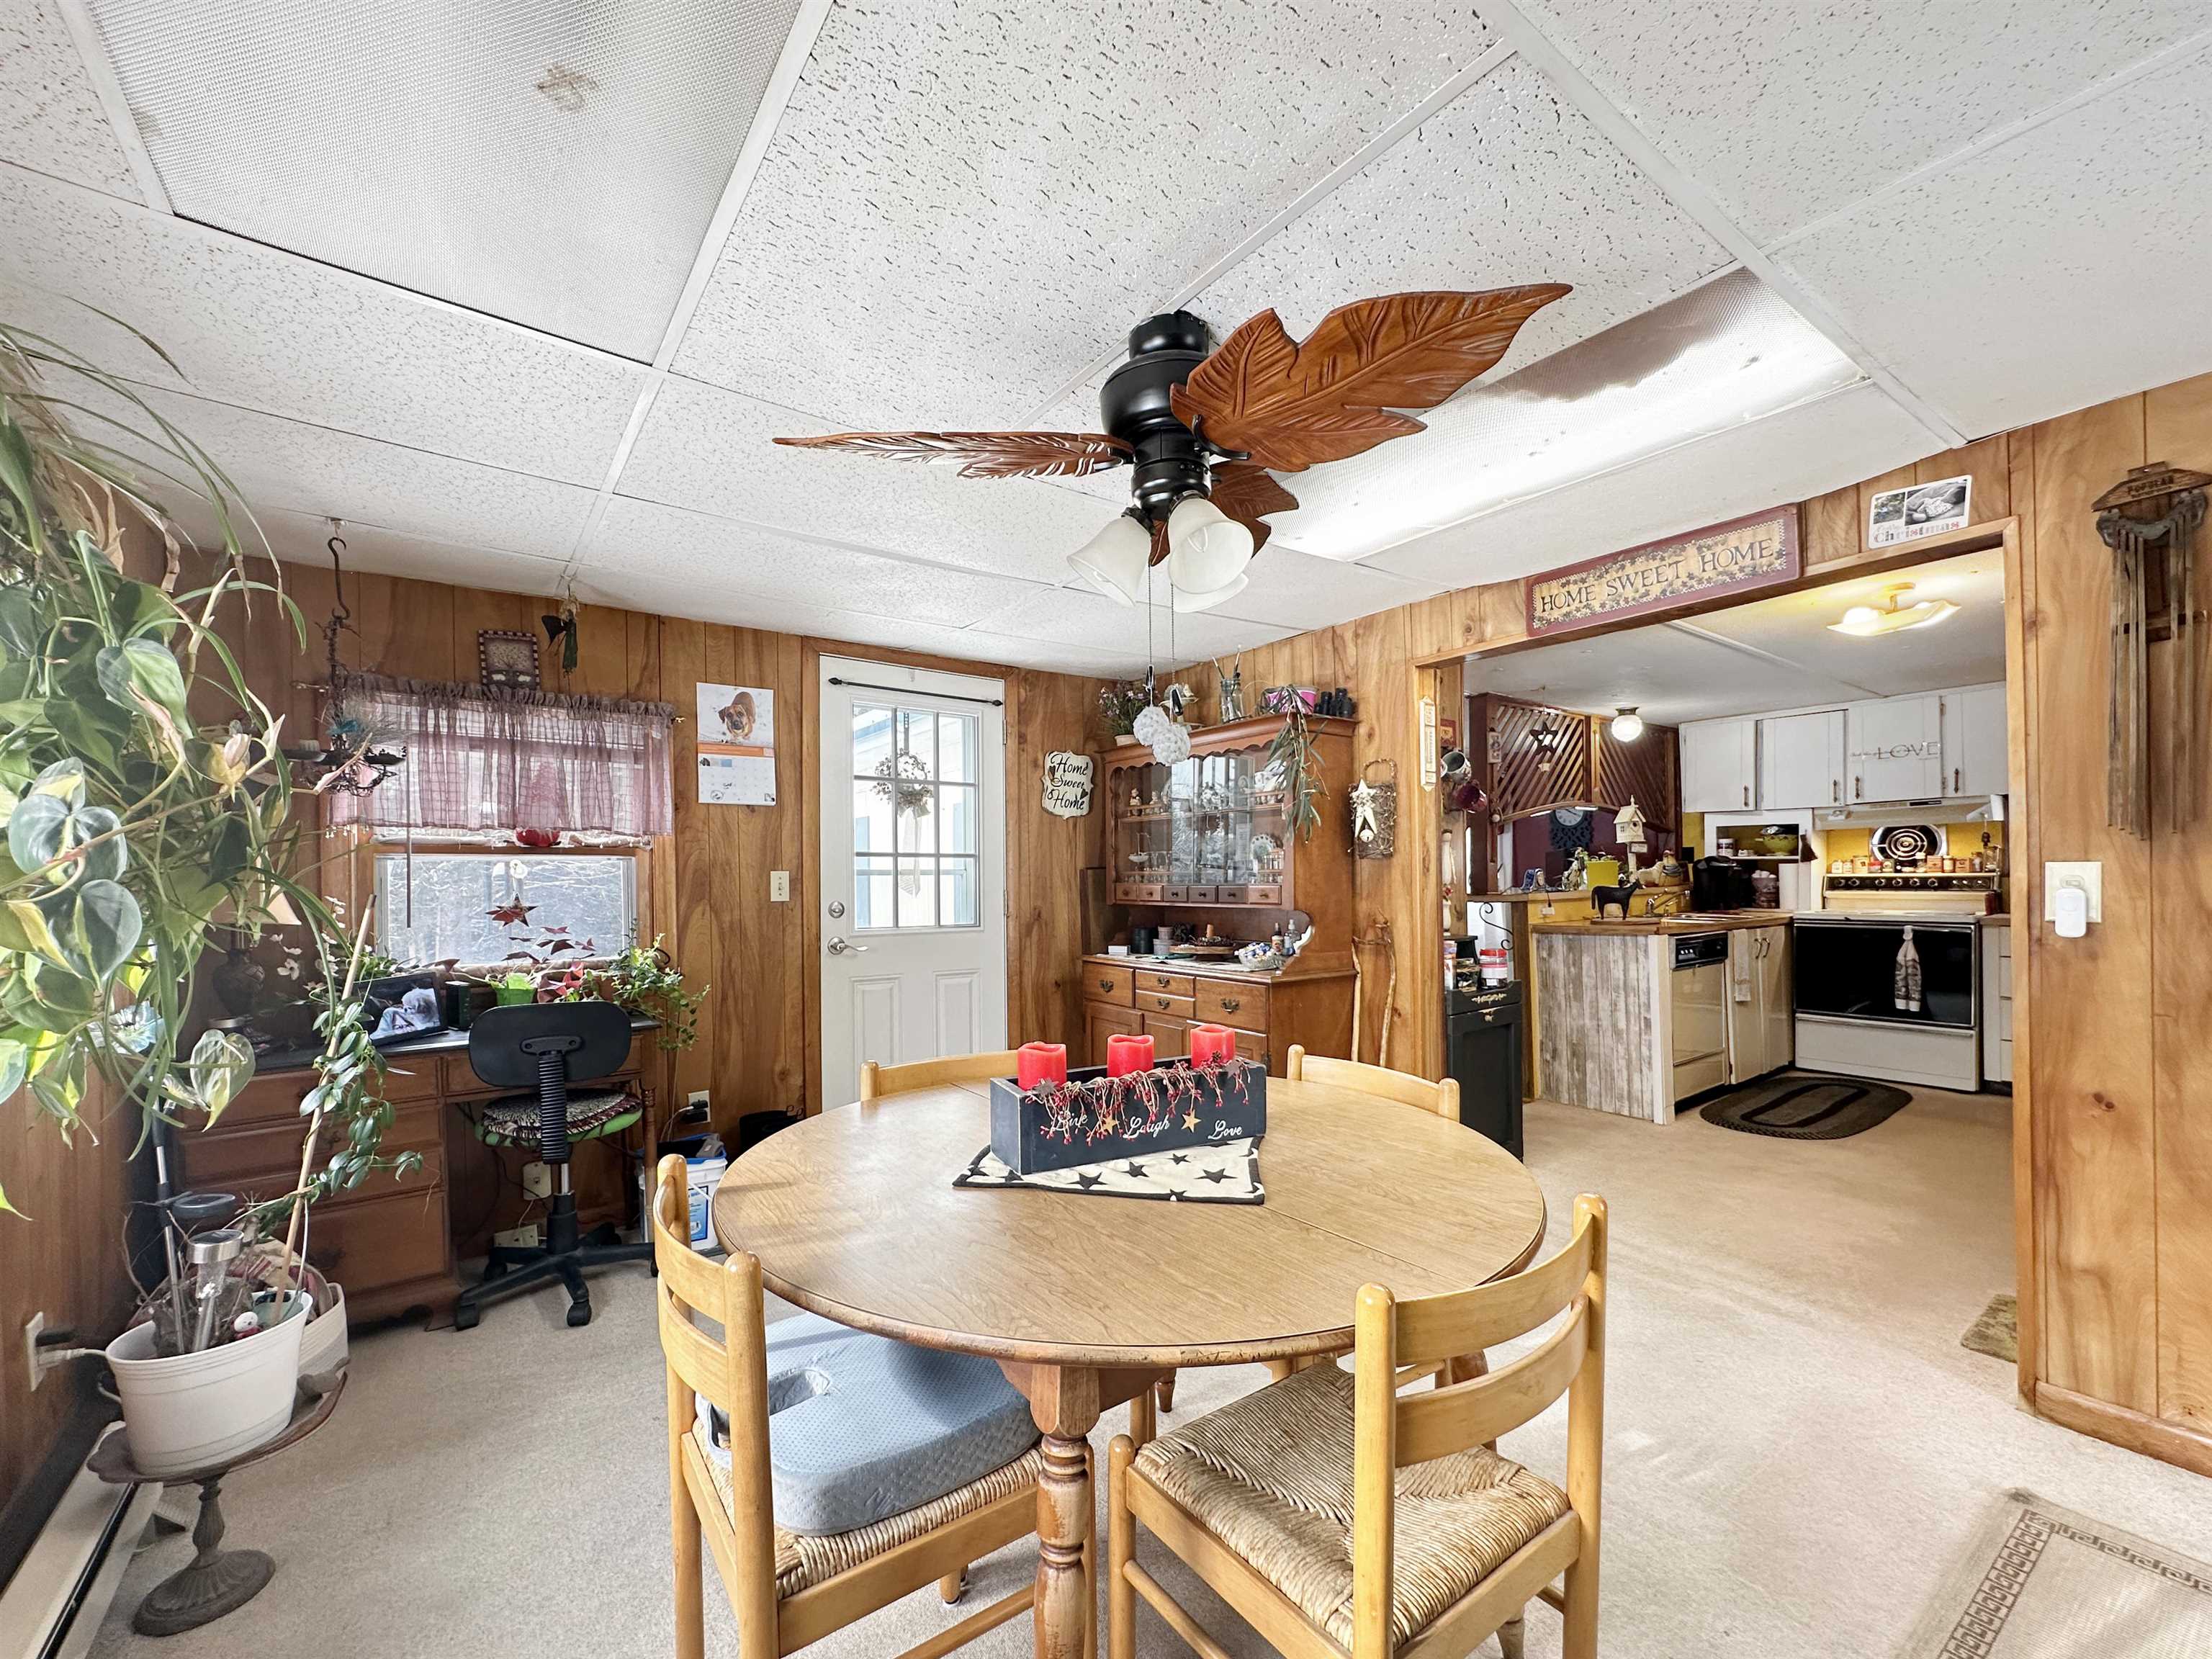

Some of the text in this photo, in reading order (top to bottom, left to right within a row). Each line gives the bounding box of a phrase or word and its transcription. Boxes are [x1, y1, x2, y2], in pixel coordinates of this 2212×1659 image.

[1540, 538, 1773, 612] HOME SWEET HOME
[1877, 741, 1939, 760] LOVE
[1051, 753, 1088, 775] Home
[1051, 774, 1085, 788] Sweet
[1047, 788, 1085, 810] Home
[1123, 1115, 1170, 1139] Laugh
[1208, 1120, 1242, 1140] Love
